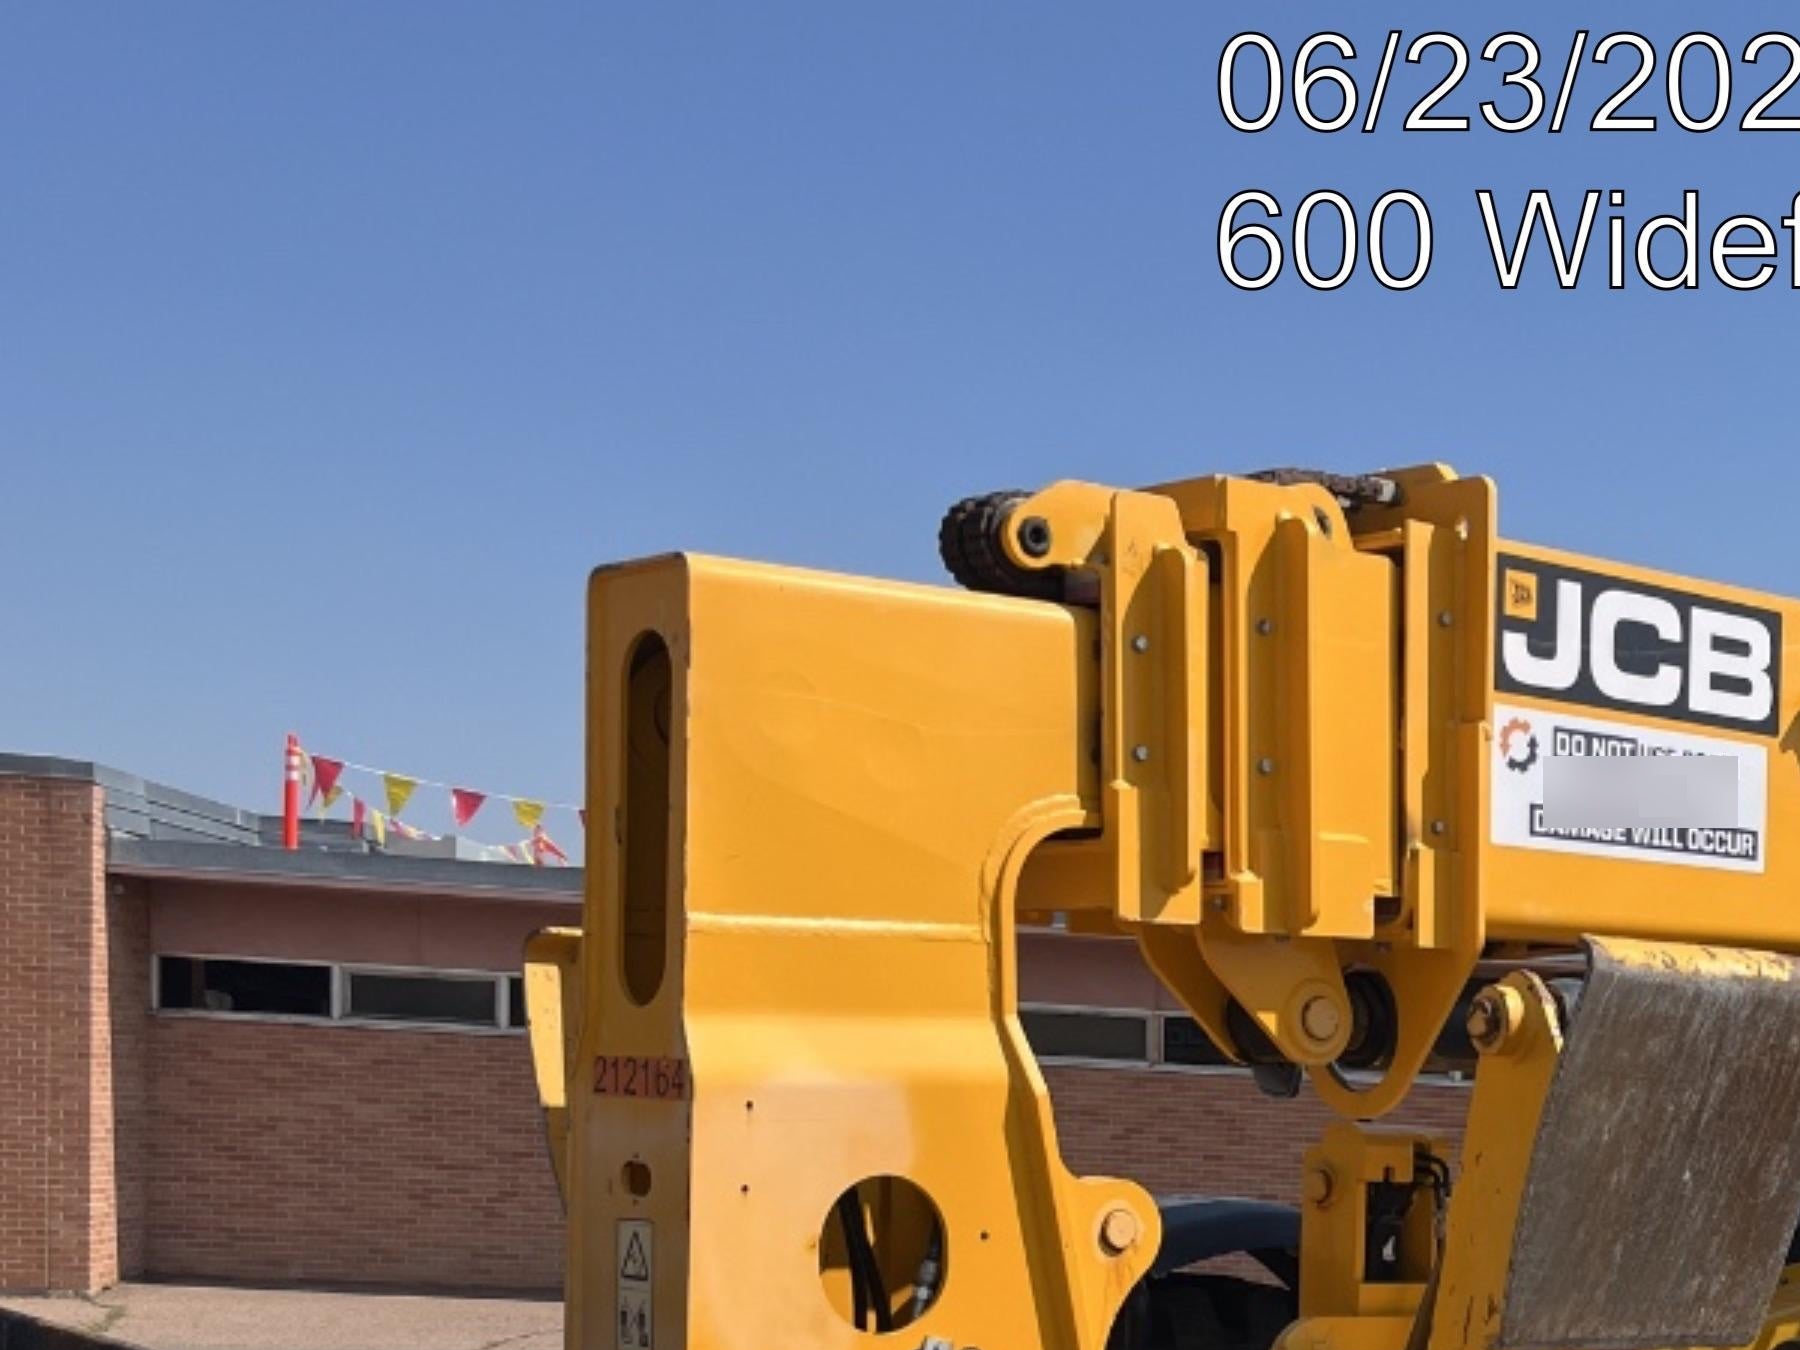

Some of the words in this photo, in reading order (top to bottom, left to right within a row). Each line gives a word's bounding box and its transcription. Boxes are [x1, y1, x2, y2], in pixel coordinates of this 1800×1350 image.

[1502, 578, 1774, 722] JCB
[1687, 829, 1755, 856] OCCUR
[593, 1055, 685, 1100] 212164
